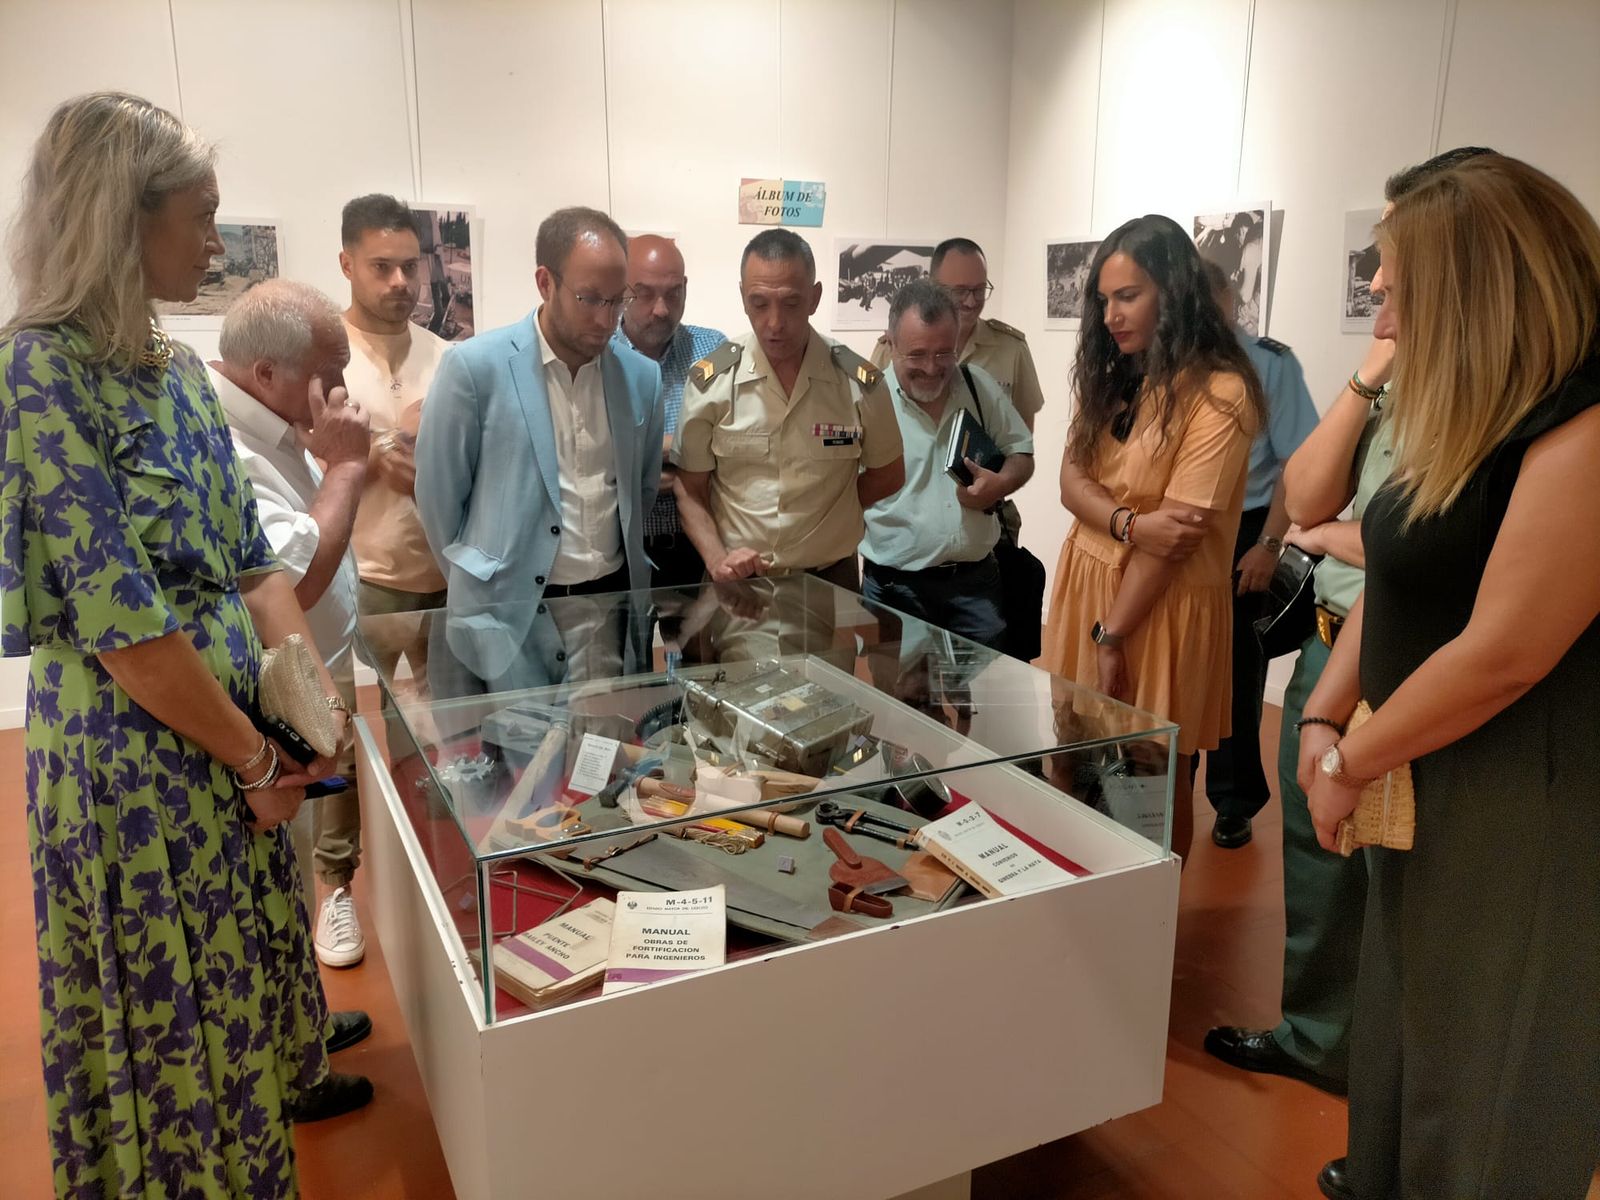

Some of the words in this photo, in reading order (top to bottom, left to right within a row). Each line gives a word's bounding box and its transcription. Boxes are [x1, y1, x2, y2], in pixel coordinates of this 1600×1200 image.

[754, 186, 795, 202] ÁLBUM
[796, 191, 813, 203] DE
[764, 206, 802, 218] FOTOS
[978, 843, 1009, 859] MANUAL
[665, 896, 713, 906] M-4-5-11
[560, 922, 594, 941] MANUAL
[641, 927, 691, 936] MANUAL
[543, 932, 571, 948] PUENTE
[643, 938, 674, 946] OBRAS
[546, 945, 571, 960] ANCHO
[632, 945, 700, 954] FORTIFICACION
[625, 952, 650, 960] PARA
[653, 953, 706, 961] INGENIEROS
